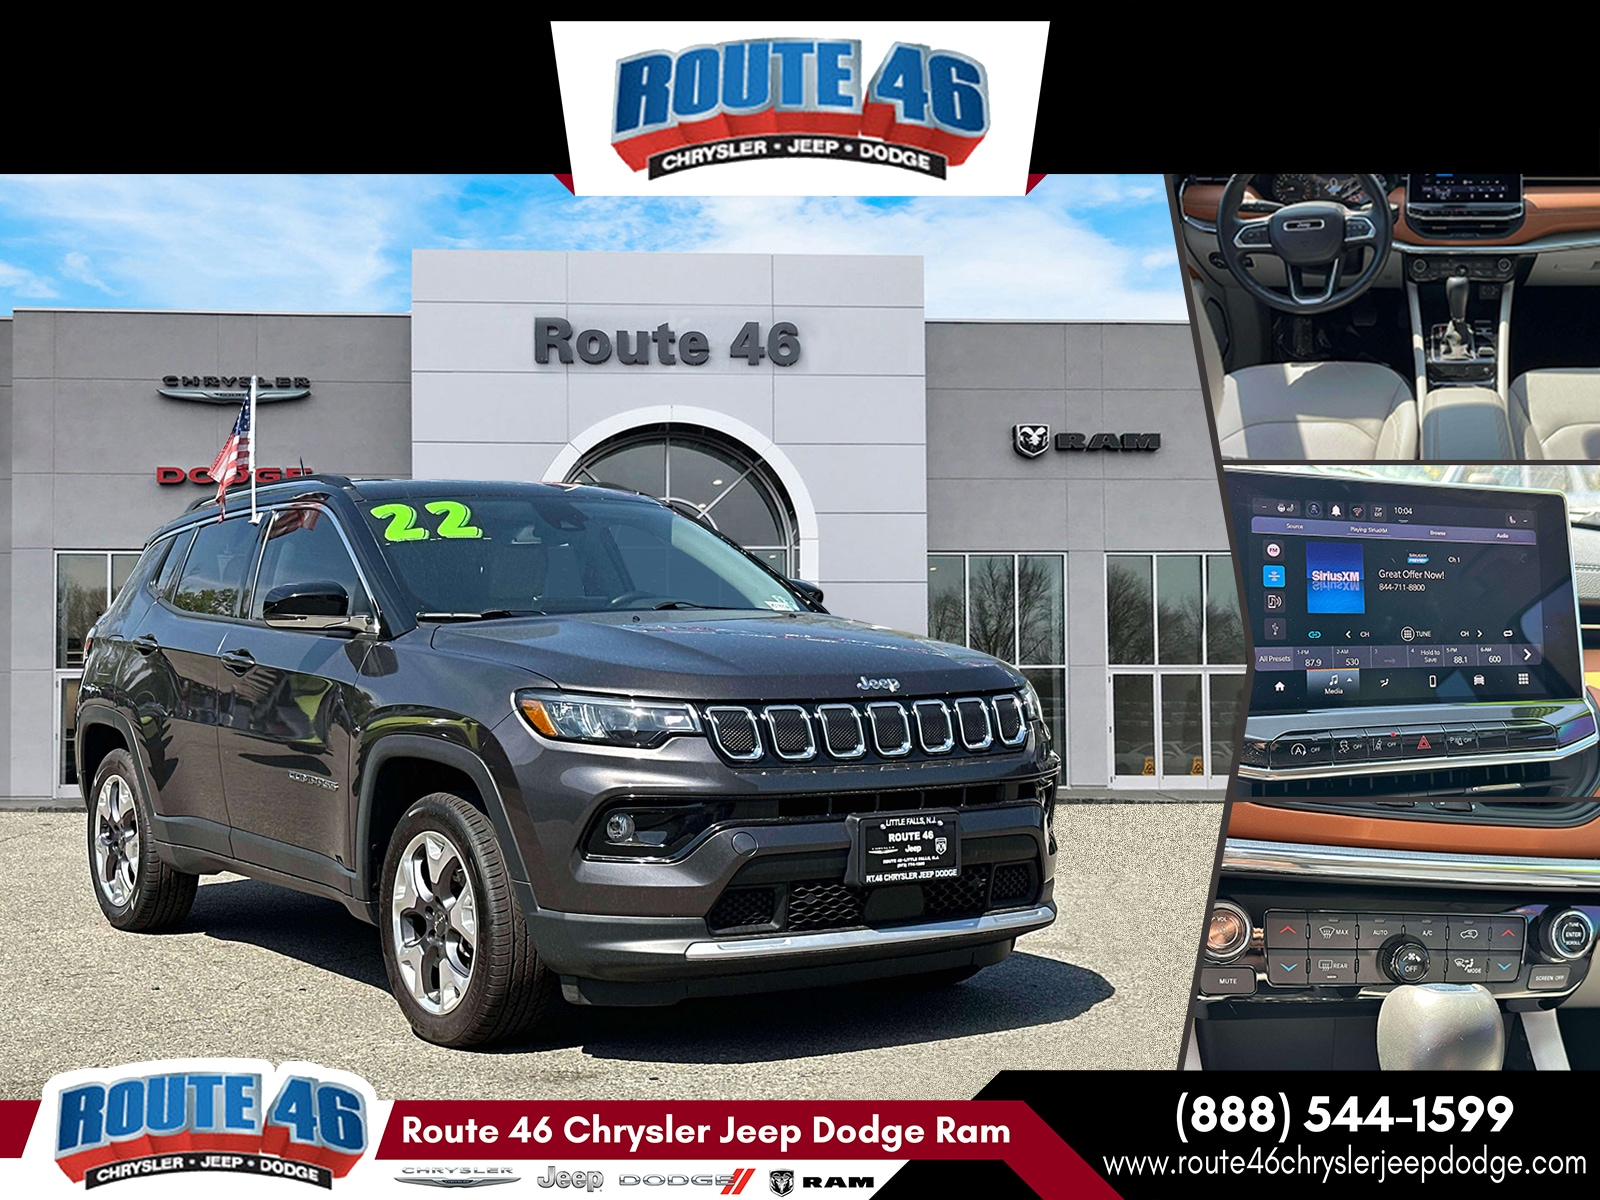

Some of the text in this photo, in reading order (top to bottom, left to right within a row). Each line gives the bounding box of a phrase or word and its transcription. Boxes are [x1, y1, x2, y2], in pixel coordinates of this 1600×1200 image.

[534, 317, 801, 366] Route 46
[162, 375, 311, 388] CHRYSLER
[1055, 433, 1161, 451] RAM
[1394, 506, 1413, 515] 10:04
[370, 501, 483, 542] 22
[1312, 570, 1360, 582] SiriusXM
[1378, 569, 1445, 580] Great Offer Now!
[1378, 583, 1426, 592] 844-711-8800
[1360, 630, 1370, 638] CH
[1416, 630, 1431, 638] TUNE
[1305, 659, 1322, 667] 87.9
[1345, 658, 1360, 666] 530
[1453, 656, 1468, 664] 88.1
[1488, 655, 1502, 663] 600
[857, 676, 901, 693] Jeep
[885, 818, 906, 826] LITTLE
[906, 817, 926, 825] FALLS,
[888, 830, 934, 842] ROUTE 46
[904, 844, 922, 853] Jeep
[883, 871, 917, 882] CHRYSLER
[918, 870, 934, 879] JEEP
[935, 868, 958, 877] DODGE
[1404, 965, 1418, 973] OFF
